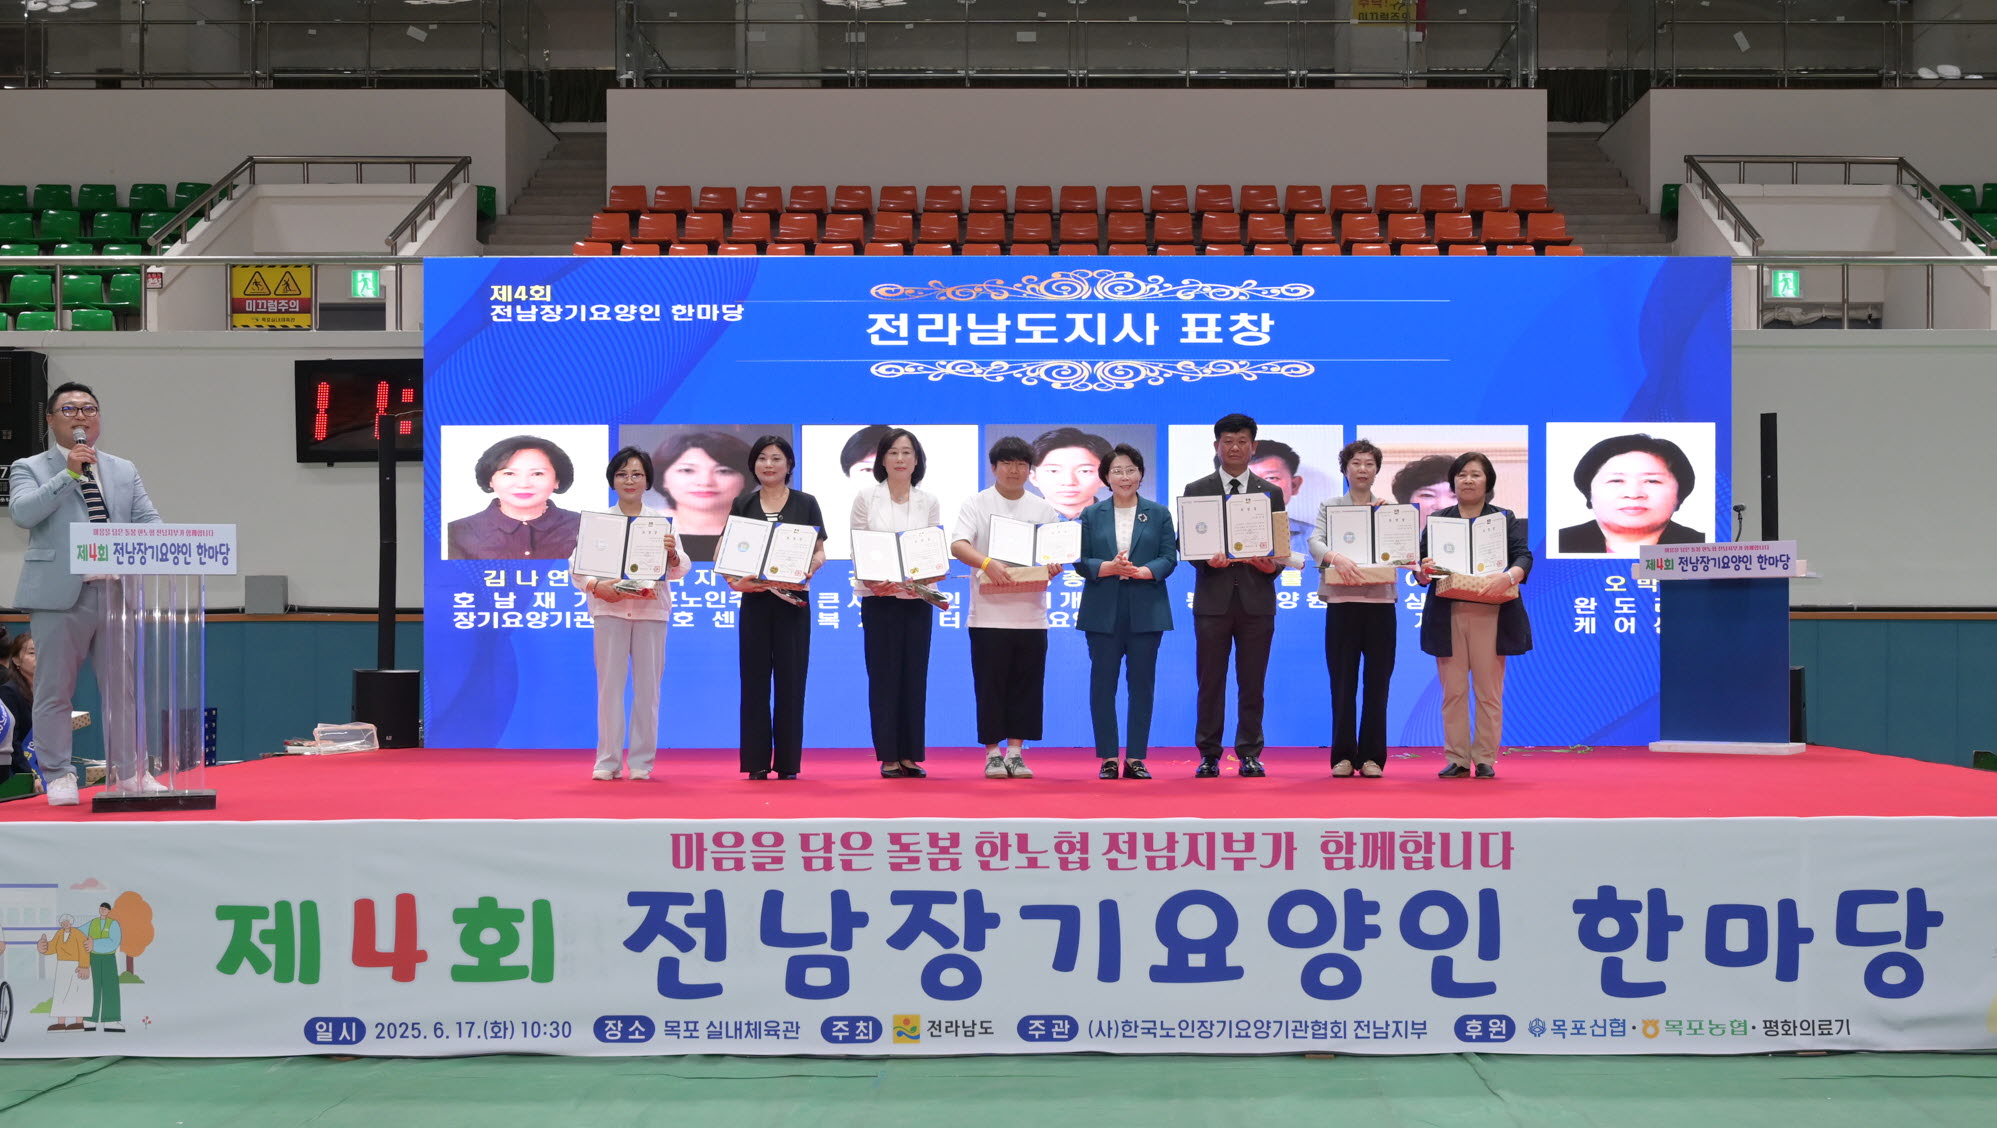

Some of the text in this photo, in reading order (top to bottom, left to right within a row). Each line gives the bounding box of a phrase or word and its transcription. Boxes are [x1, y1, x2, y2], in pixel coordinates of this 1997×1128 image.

[490, 285, 551, 302] 제4회
[245, 300, 299, 312] 미끄럼주의
[490, 304, 744, 322] 전남장기요양인 한마당
[866, 313, 1275, 346] 전라남도지사 표창
[77, 542, 230, 565] 제4회 전남장기요양인 한마당
[1645, 553, 1791, 573] 제4회 전남장기요양인 한마당
[670, 830, 1515, 872] 마음을 담은 돌봄 한노협 전남지부가 함께합니다
[215, 884, 1945, 1002] 제4회 전남장기요양인 한마당
[374, 1021, 427, 1040] 2025.
[433, 1021, 449, 1039] 6.
[521, 1020, 572, 1039] 10:30
[663, 1020, 700, 1039] 목포
[706, 1020, 801, 1040] 실내체육관
[926, 1019, 995, 1037] 전라남도
[1088, 1019, 1347, 1040] (사)한국노인장기요양기관협회
[1353, 1019, 1428, 1040] 전남지부
[1550, 1018, 1626, 1039] 목포신협
[1664, 1018, 1748, 1037] 목포농협
[1762, 1018, 1851, 1037] 평화의료기
